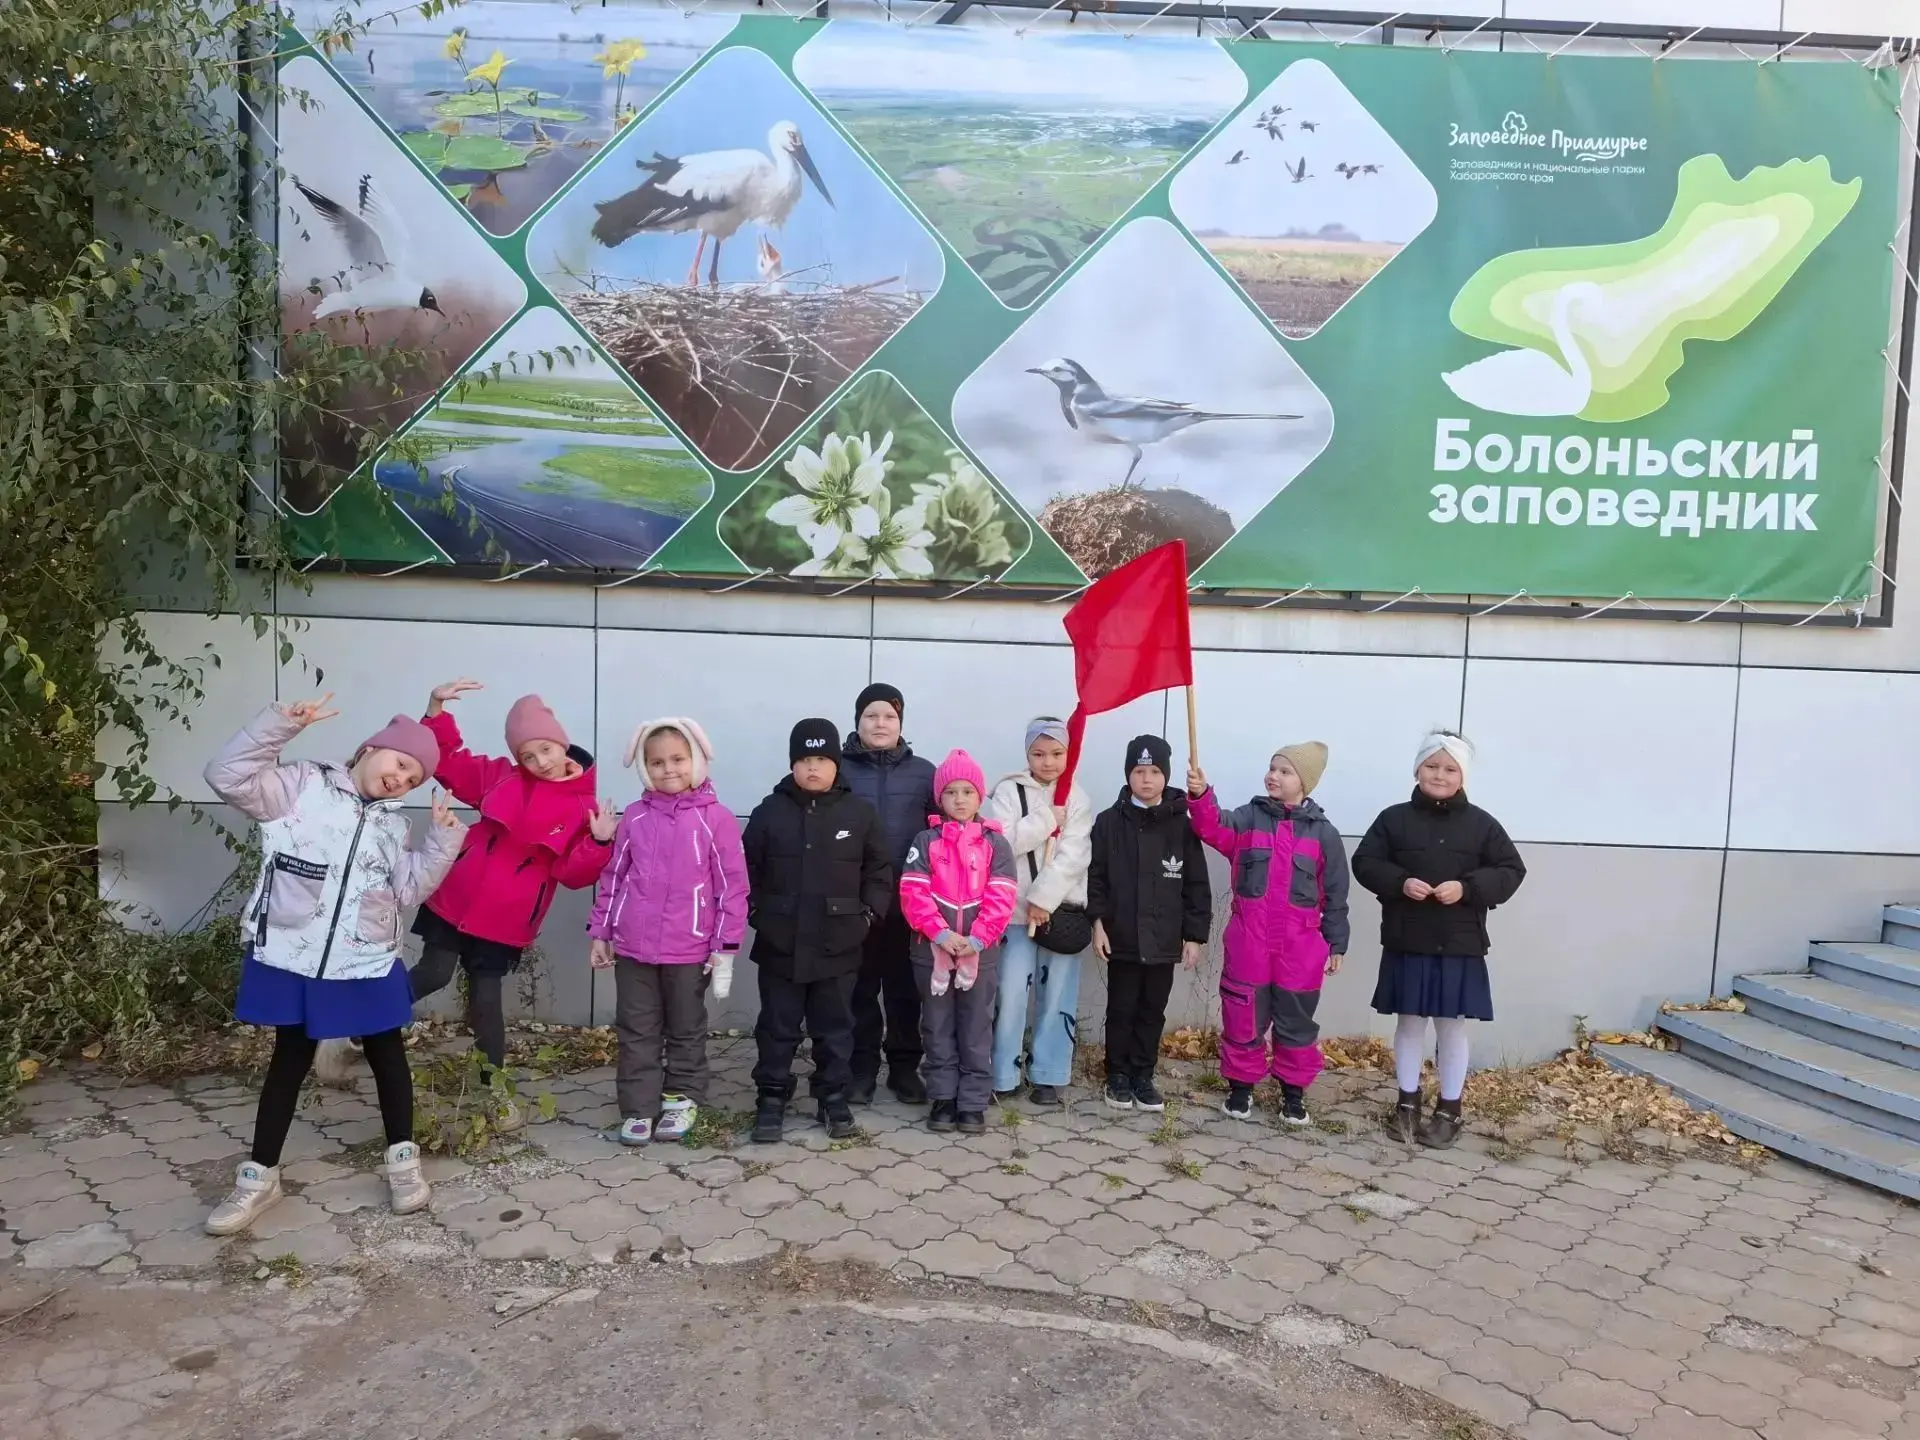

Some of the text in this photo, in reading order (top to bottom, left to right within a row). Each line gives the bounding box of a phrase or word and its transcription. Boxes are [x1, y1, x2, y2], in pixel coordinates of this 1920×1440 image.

[1449, 112, 1648, 161] Заповедное Приамурье
[1450, 158, 1522, 170] Заповедники
[1533, 163, 1610, 175] национальные
[1612, 165, 1645, 175] парки
[1450, 170, 1554, 184] Хабаровского края
[1434, 418, 1818, 480] Болоньский
[1428, 484, 1819, 537] заповедник
[805, 739, 826, 748] GAP
